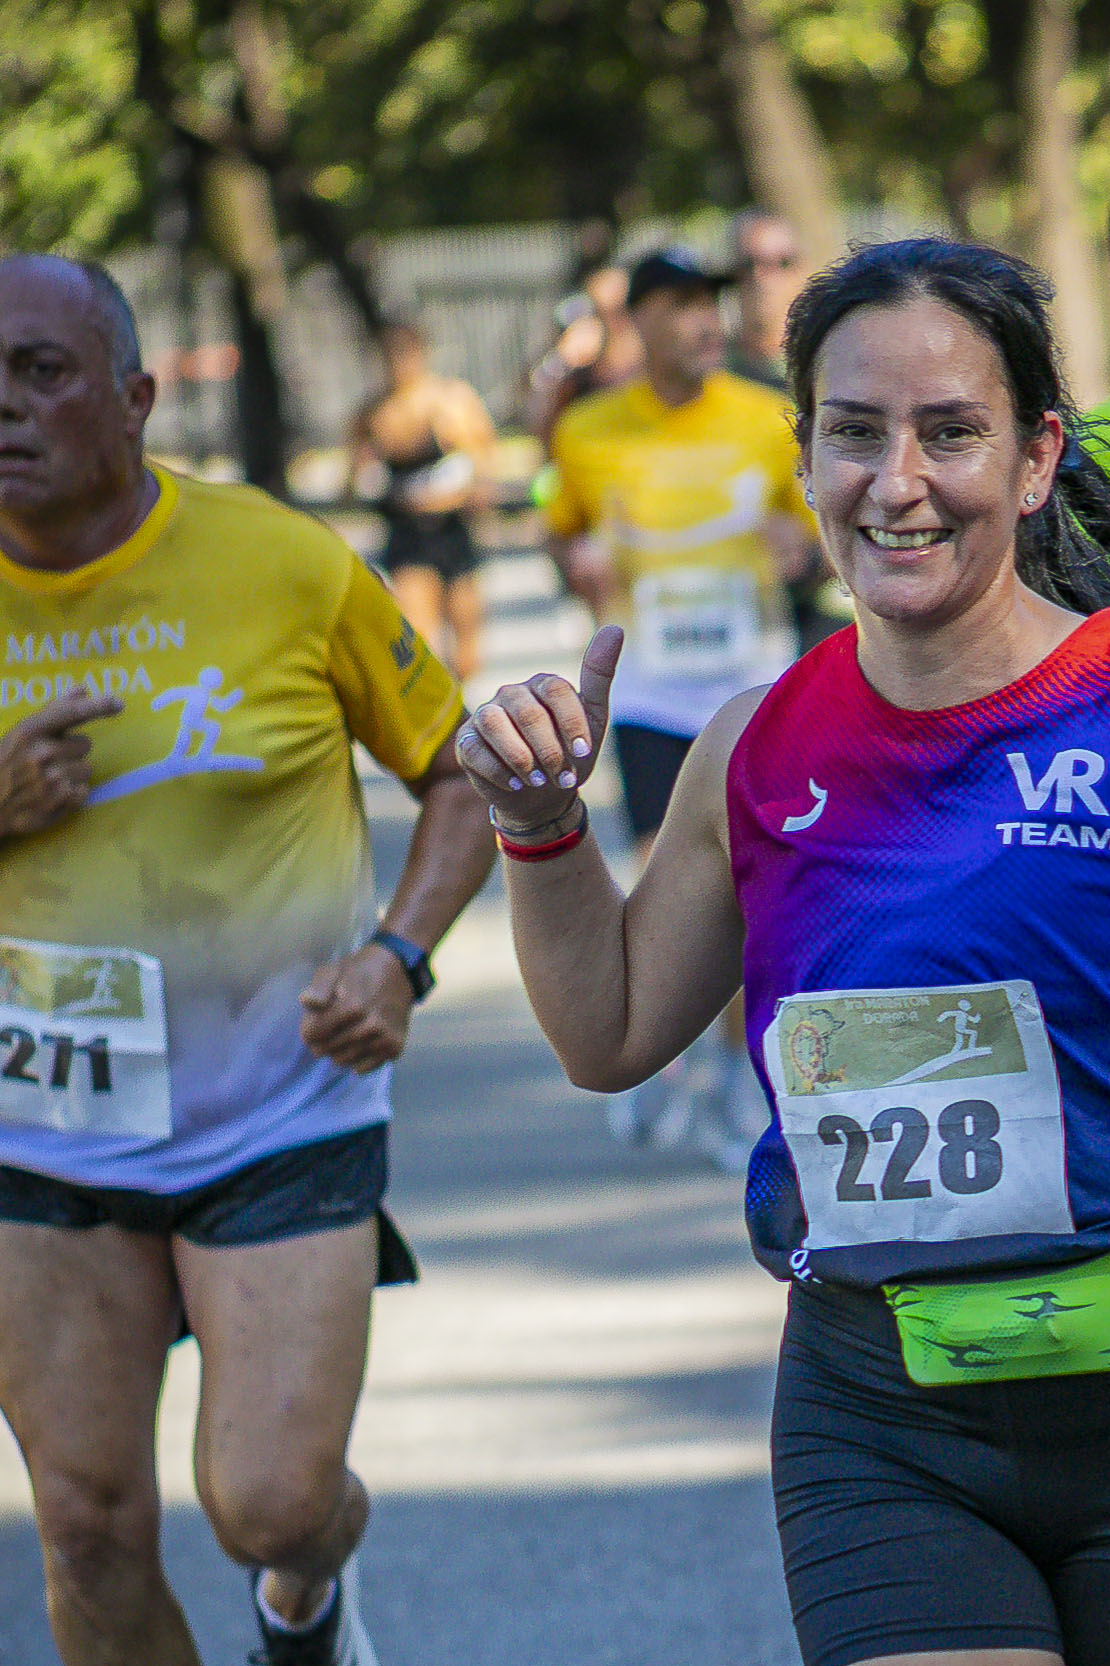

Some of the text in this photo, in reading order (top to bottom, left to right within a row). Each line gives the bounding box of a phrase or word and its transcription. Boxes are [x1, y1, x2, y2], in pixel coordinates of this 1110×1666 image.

[6, 615, 185, 664] MARATÓN
[1006, 748, 1110, 816] VR
[0, 1026, 113, 1092] 271
[817, 1099, 1003, 1202] 228
